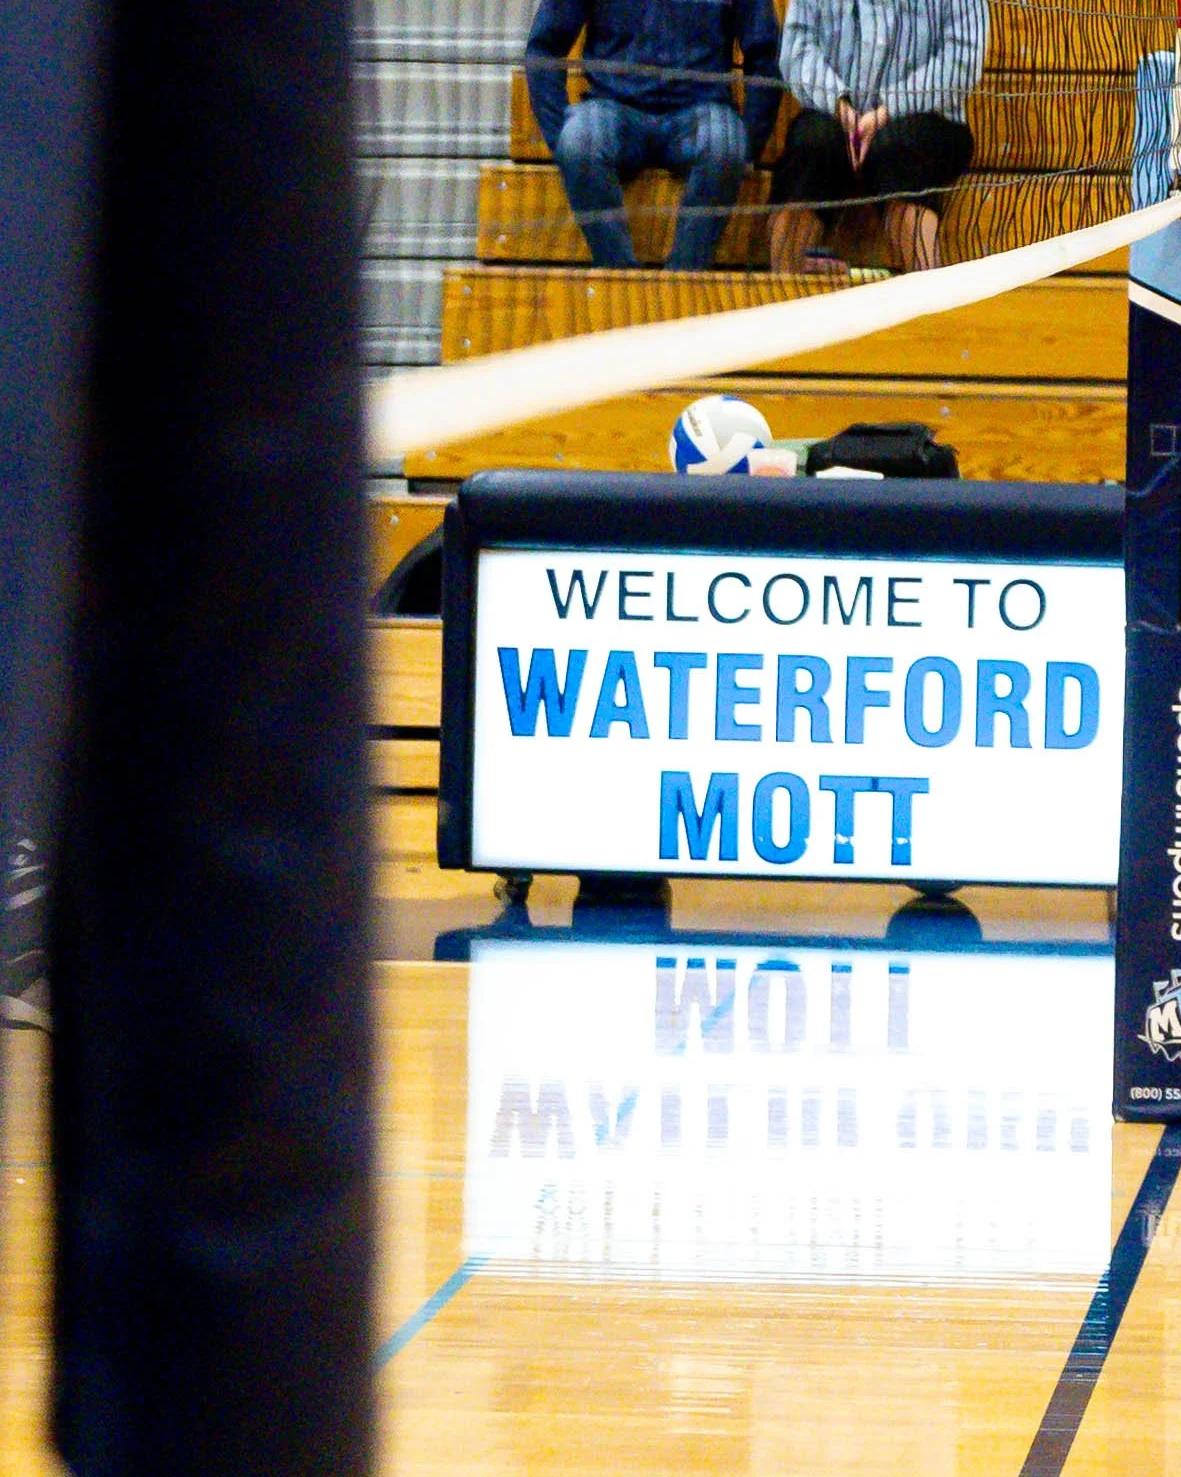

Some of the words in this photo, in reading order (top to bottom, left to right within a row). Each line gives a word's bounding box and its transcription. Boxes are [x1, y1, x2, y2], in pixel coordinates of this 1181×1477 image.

[546, 567, 923, 628] WELCOME
[953, 577, 1047, 632] TO
[496, 646, 1101, 750] WATERFORD
[658, 770, 930, 866] MOTT
[1130, 1087, 1163, 1101] (800)
